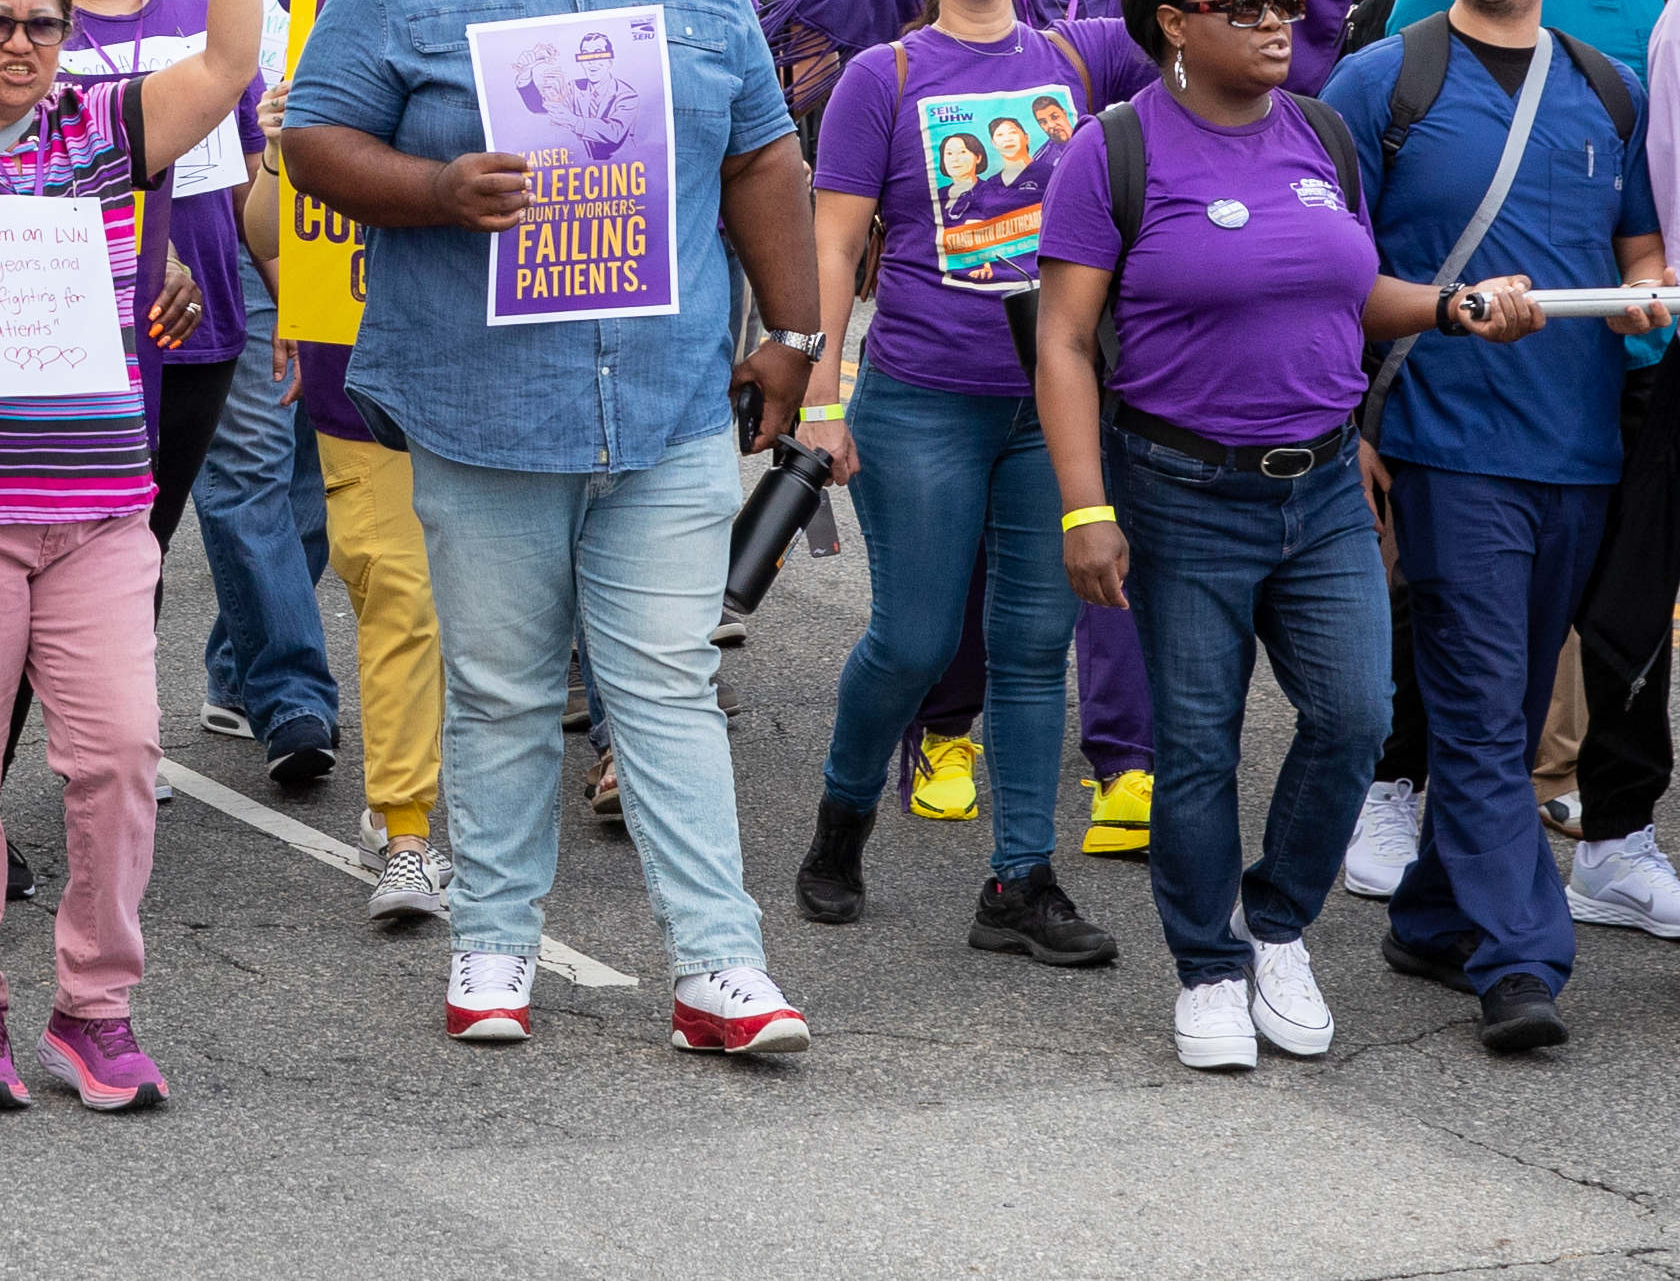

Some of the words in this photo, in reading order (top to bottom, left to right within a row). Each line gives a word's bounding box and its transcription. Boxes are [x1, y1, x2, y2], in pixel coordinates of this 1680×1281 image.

[632, 32, 655, 41] SEIU
[930, 105, 963, 117] SEIU-
[939, 112, 973, 123] UHW
[23, 229, 43, 243] an
[56, 227, 88, 243] LVN
[518, 216, 646, 265] FAILING
[947, 233, 973, 250] STAND
[976, 226, 994, 245] WITH
[50, 257, 80, 271] and
[516, 260, 647, 300] PATIENTS.
[64, 287, 85, 308] for
